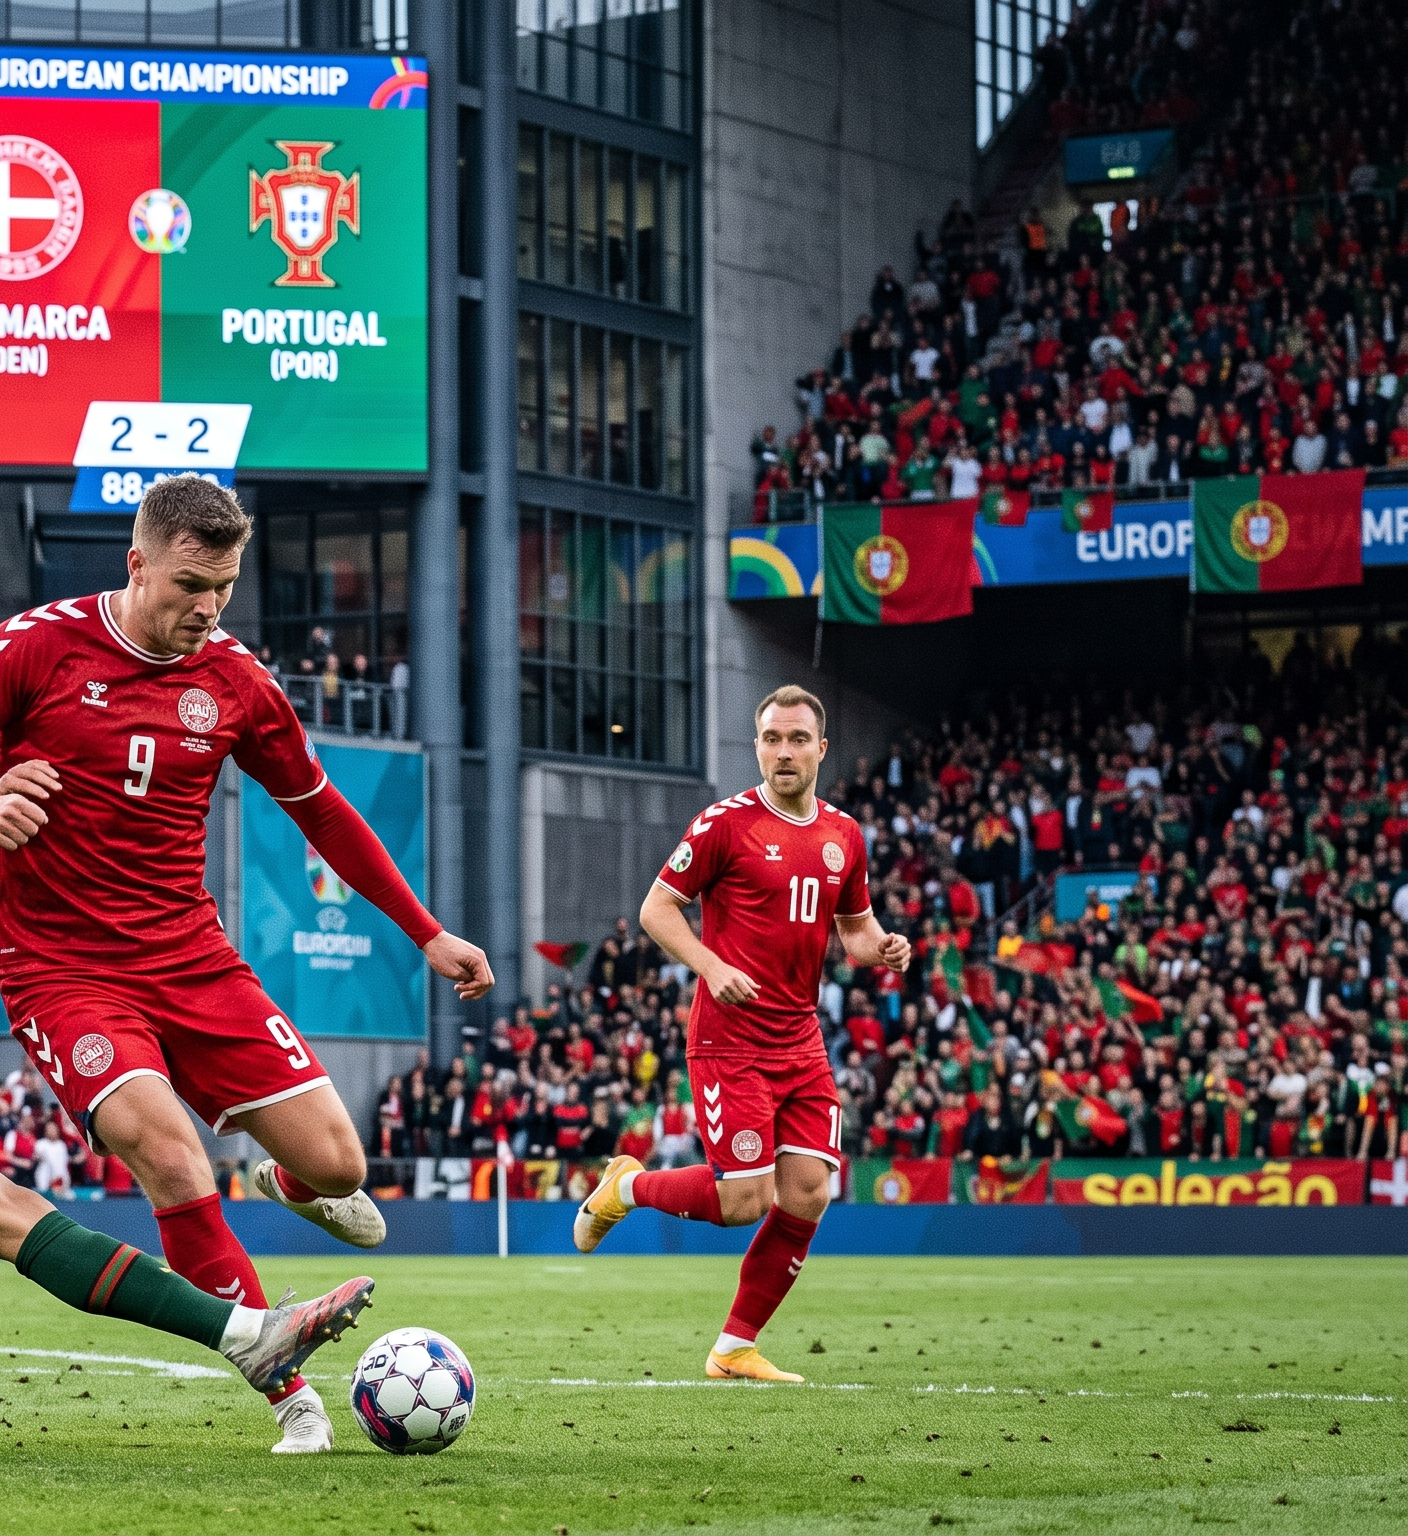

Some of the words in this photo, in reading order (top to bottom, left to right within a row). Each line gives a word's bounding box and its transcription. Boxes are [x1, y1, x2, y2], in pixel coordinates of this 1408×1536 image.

[130, 61, 349, 96] CHAMPIONSHIP
[222, 308, 388, 347] PORTUGAL
[270, 348, 339, 382] (POR)
[110, 416, 133, 452] 2
[187, 418, 210, 453] 2
[1076, 519, 1193, 563] EUROP
[124, 734, 156, 797] 9
[789, 875, 820, 924] 10
[265, 1014, 311, 1070] 9
[828, 1105, 842, 1151] 1
